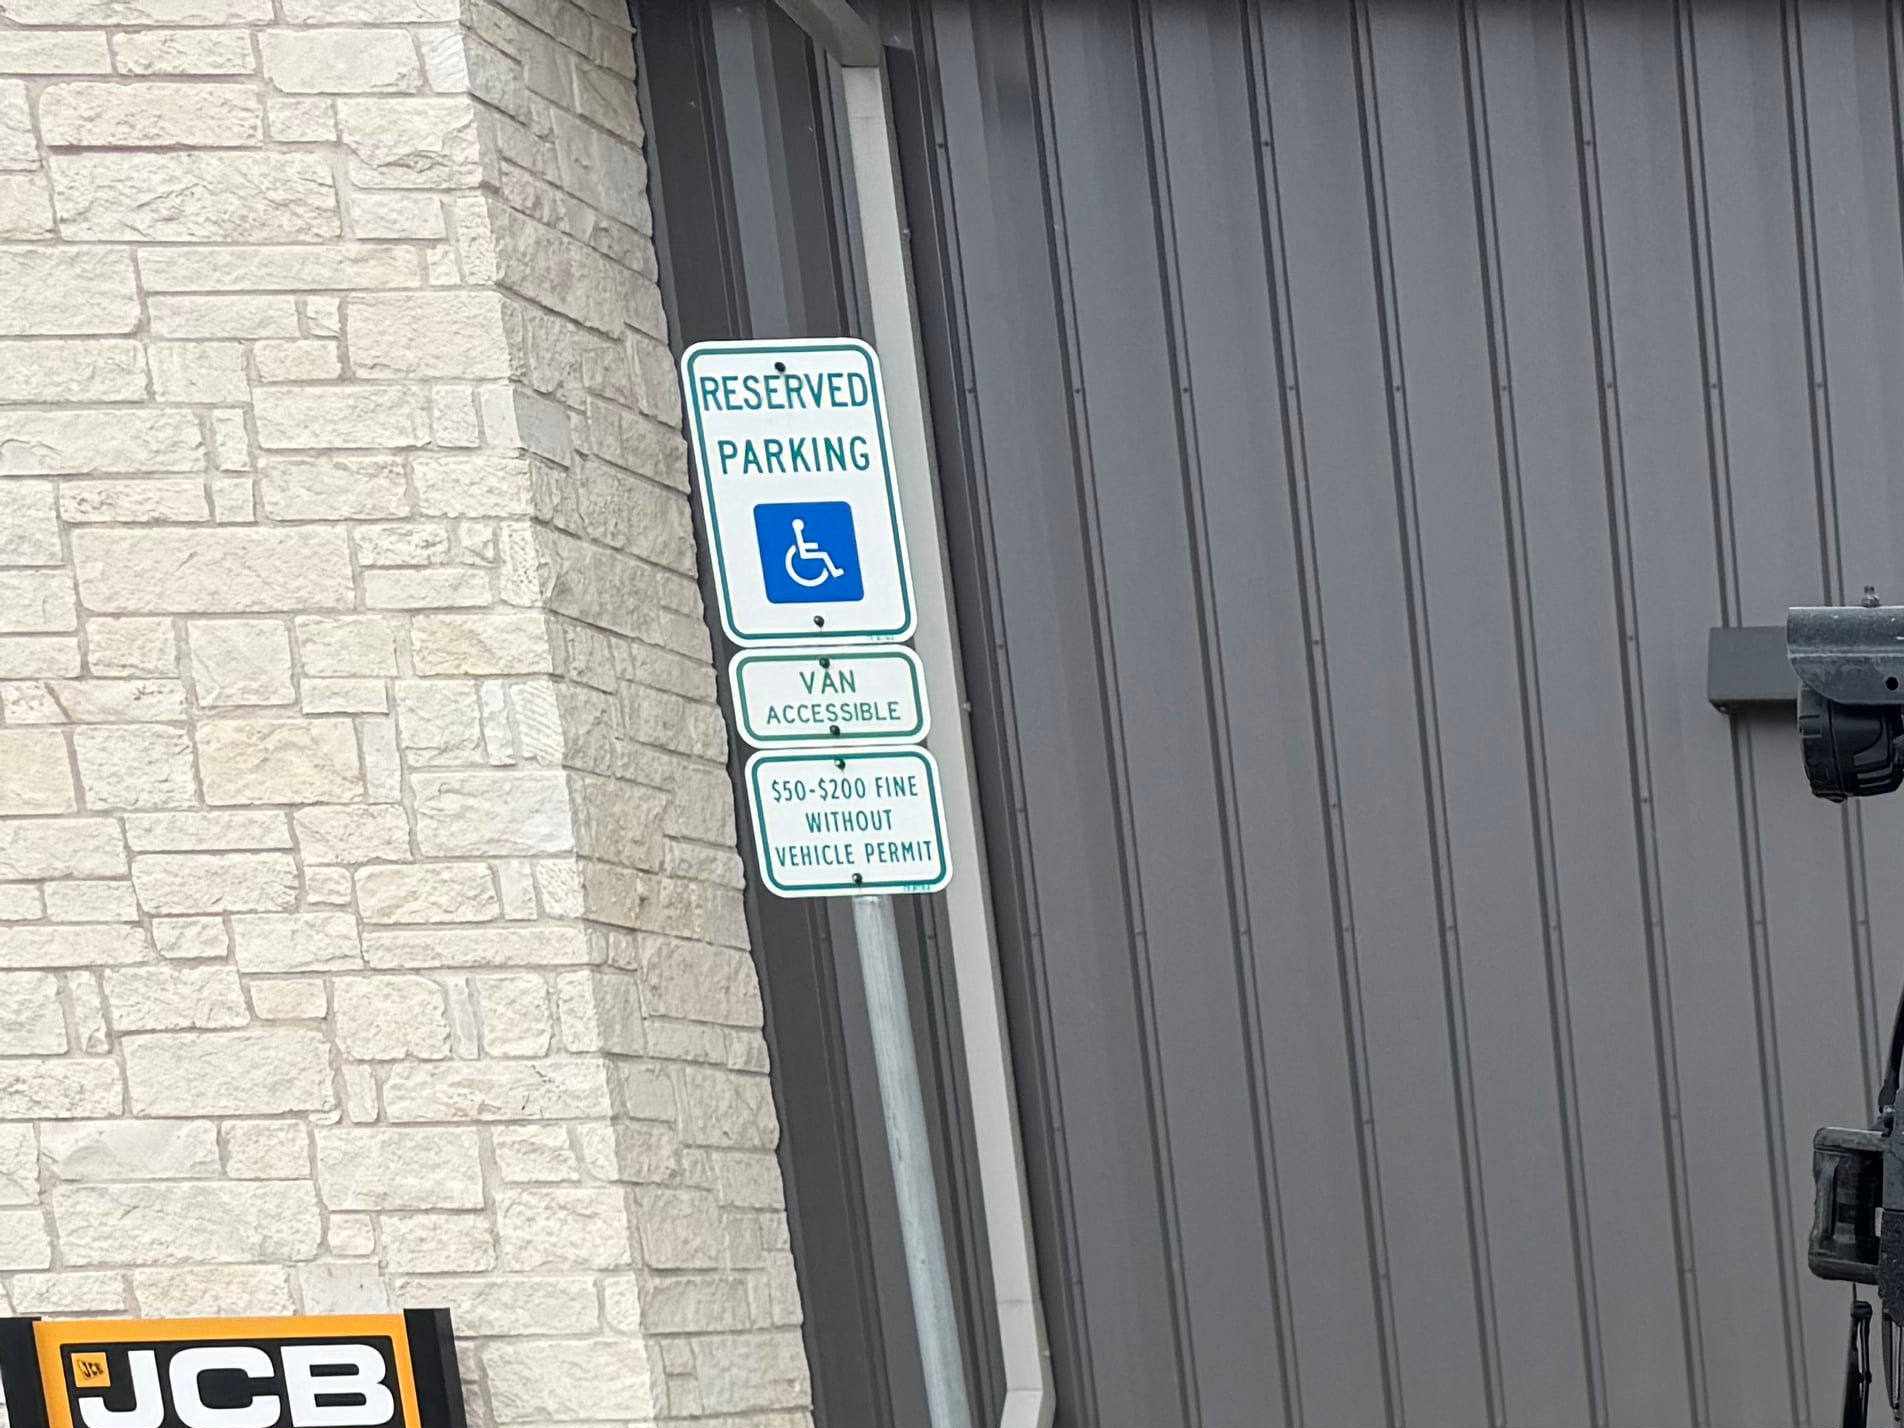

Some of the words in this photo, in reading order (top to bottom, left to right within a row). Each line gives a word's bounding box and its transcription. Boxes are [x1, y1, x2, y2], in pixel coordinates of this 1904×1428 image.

[700, 372, 869, 412] RESERVED
[718, 436, 870, 475] PARKING
[799, 670, 856, 695] VAN
[766, 701, 902, 725] ACCESSIBLE
[771, 777, 866, 802] $50-$200
[875, 776, 919, 799] FINE
[805, 809, 893, 833] WITHOUT
[775, 843, 855, 868] VEHICLE
[864, 840, 933, 866] PERMIT
